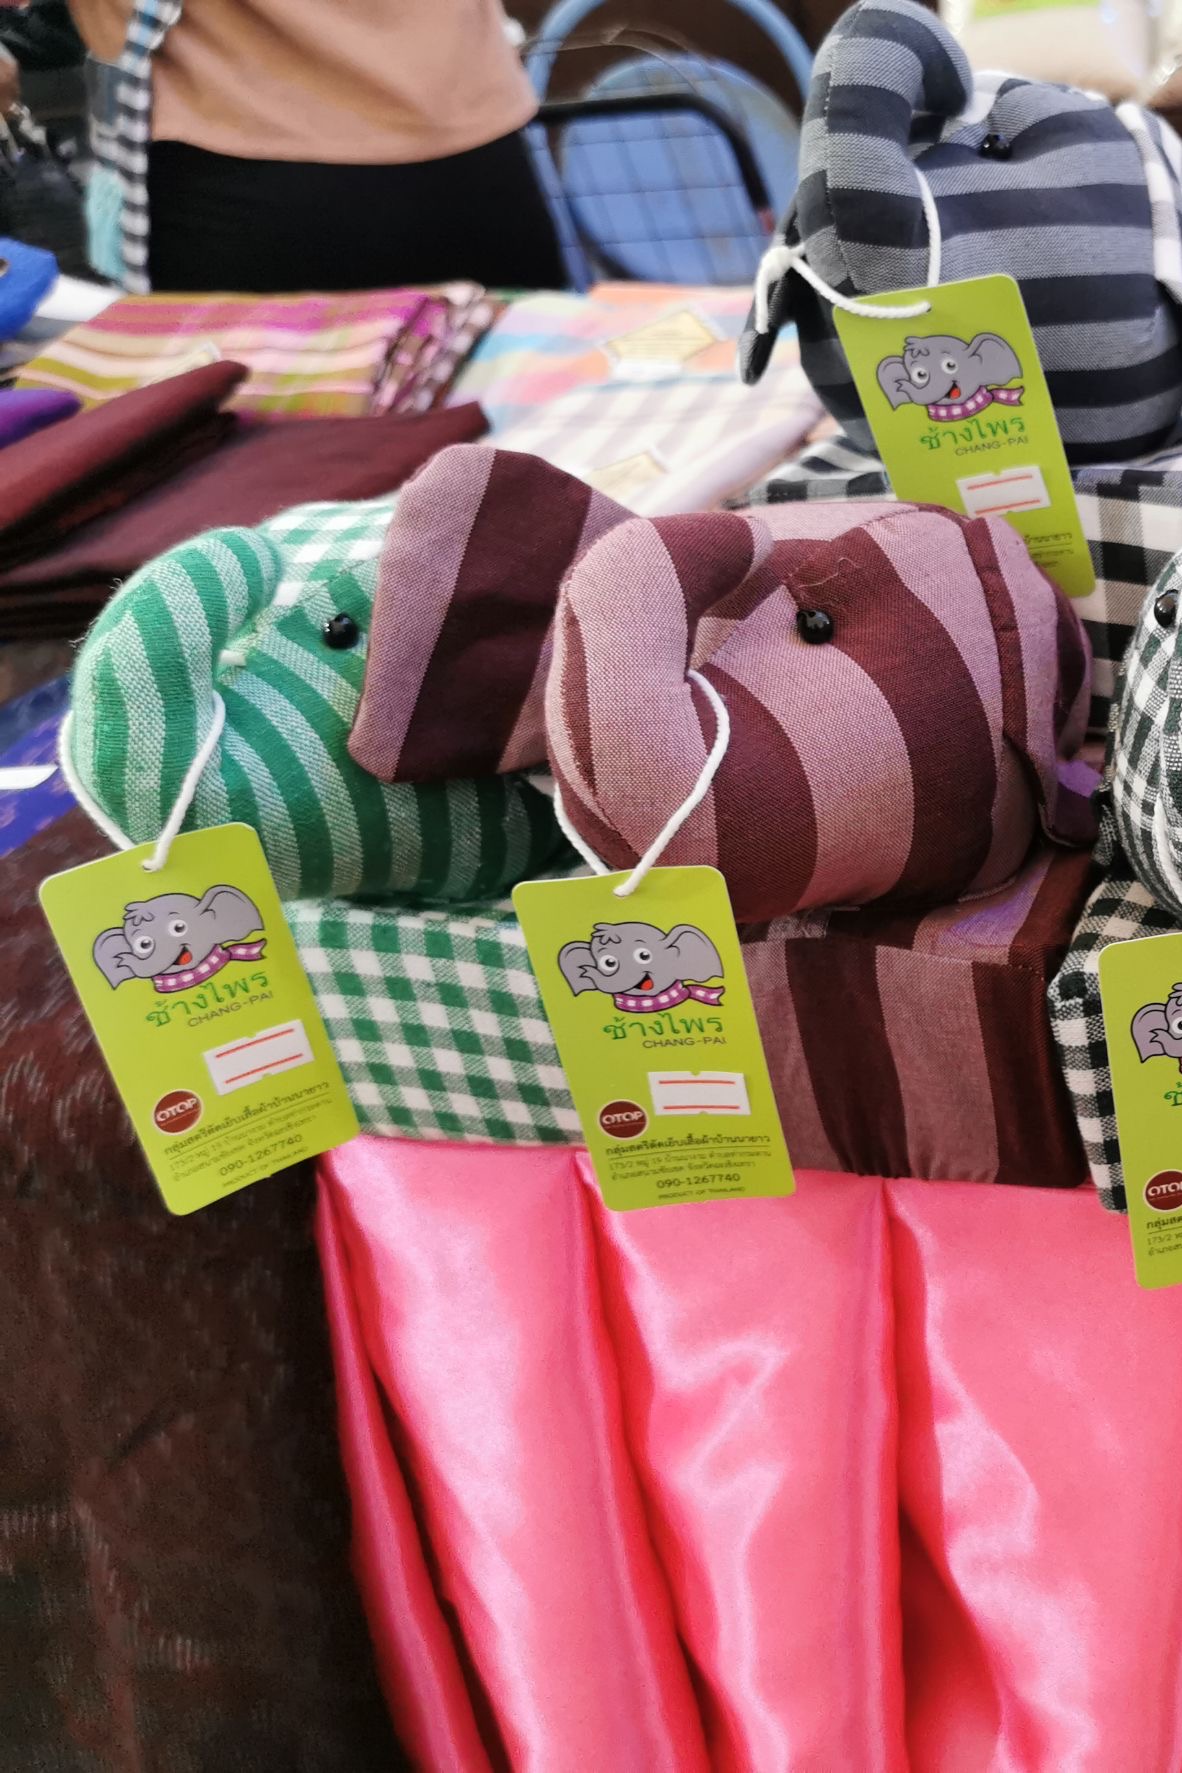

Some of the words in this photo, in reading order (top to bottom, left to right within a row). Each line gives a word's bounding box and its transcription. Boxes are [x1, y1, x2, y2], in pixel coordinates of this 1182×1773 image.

[920, 418, 1025, 450] ช้างไพร
[955, 436, 1029, 456] CHANG-PAI
[145, 971, 269, 1027] ช้างไพร
[187, 990, 274, 1027] CHANG-PAI
[602, 1012, 723, 1040] ช้างไพร
[642, 1036, 727, 1049] CHANG-PAI
[156, 1097, 198, 1122] OTOP
[602, 1111, 644, 1125] OTOP
[219, 1134, 304, 1177] 090-1267740
[656, 1173, 741, 1189] 090-1267740
